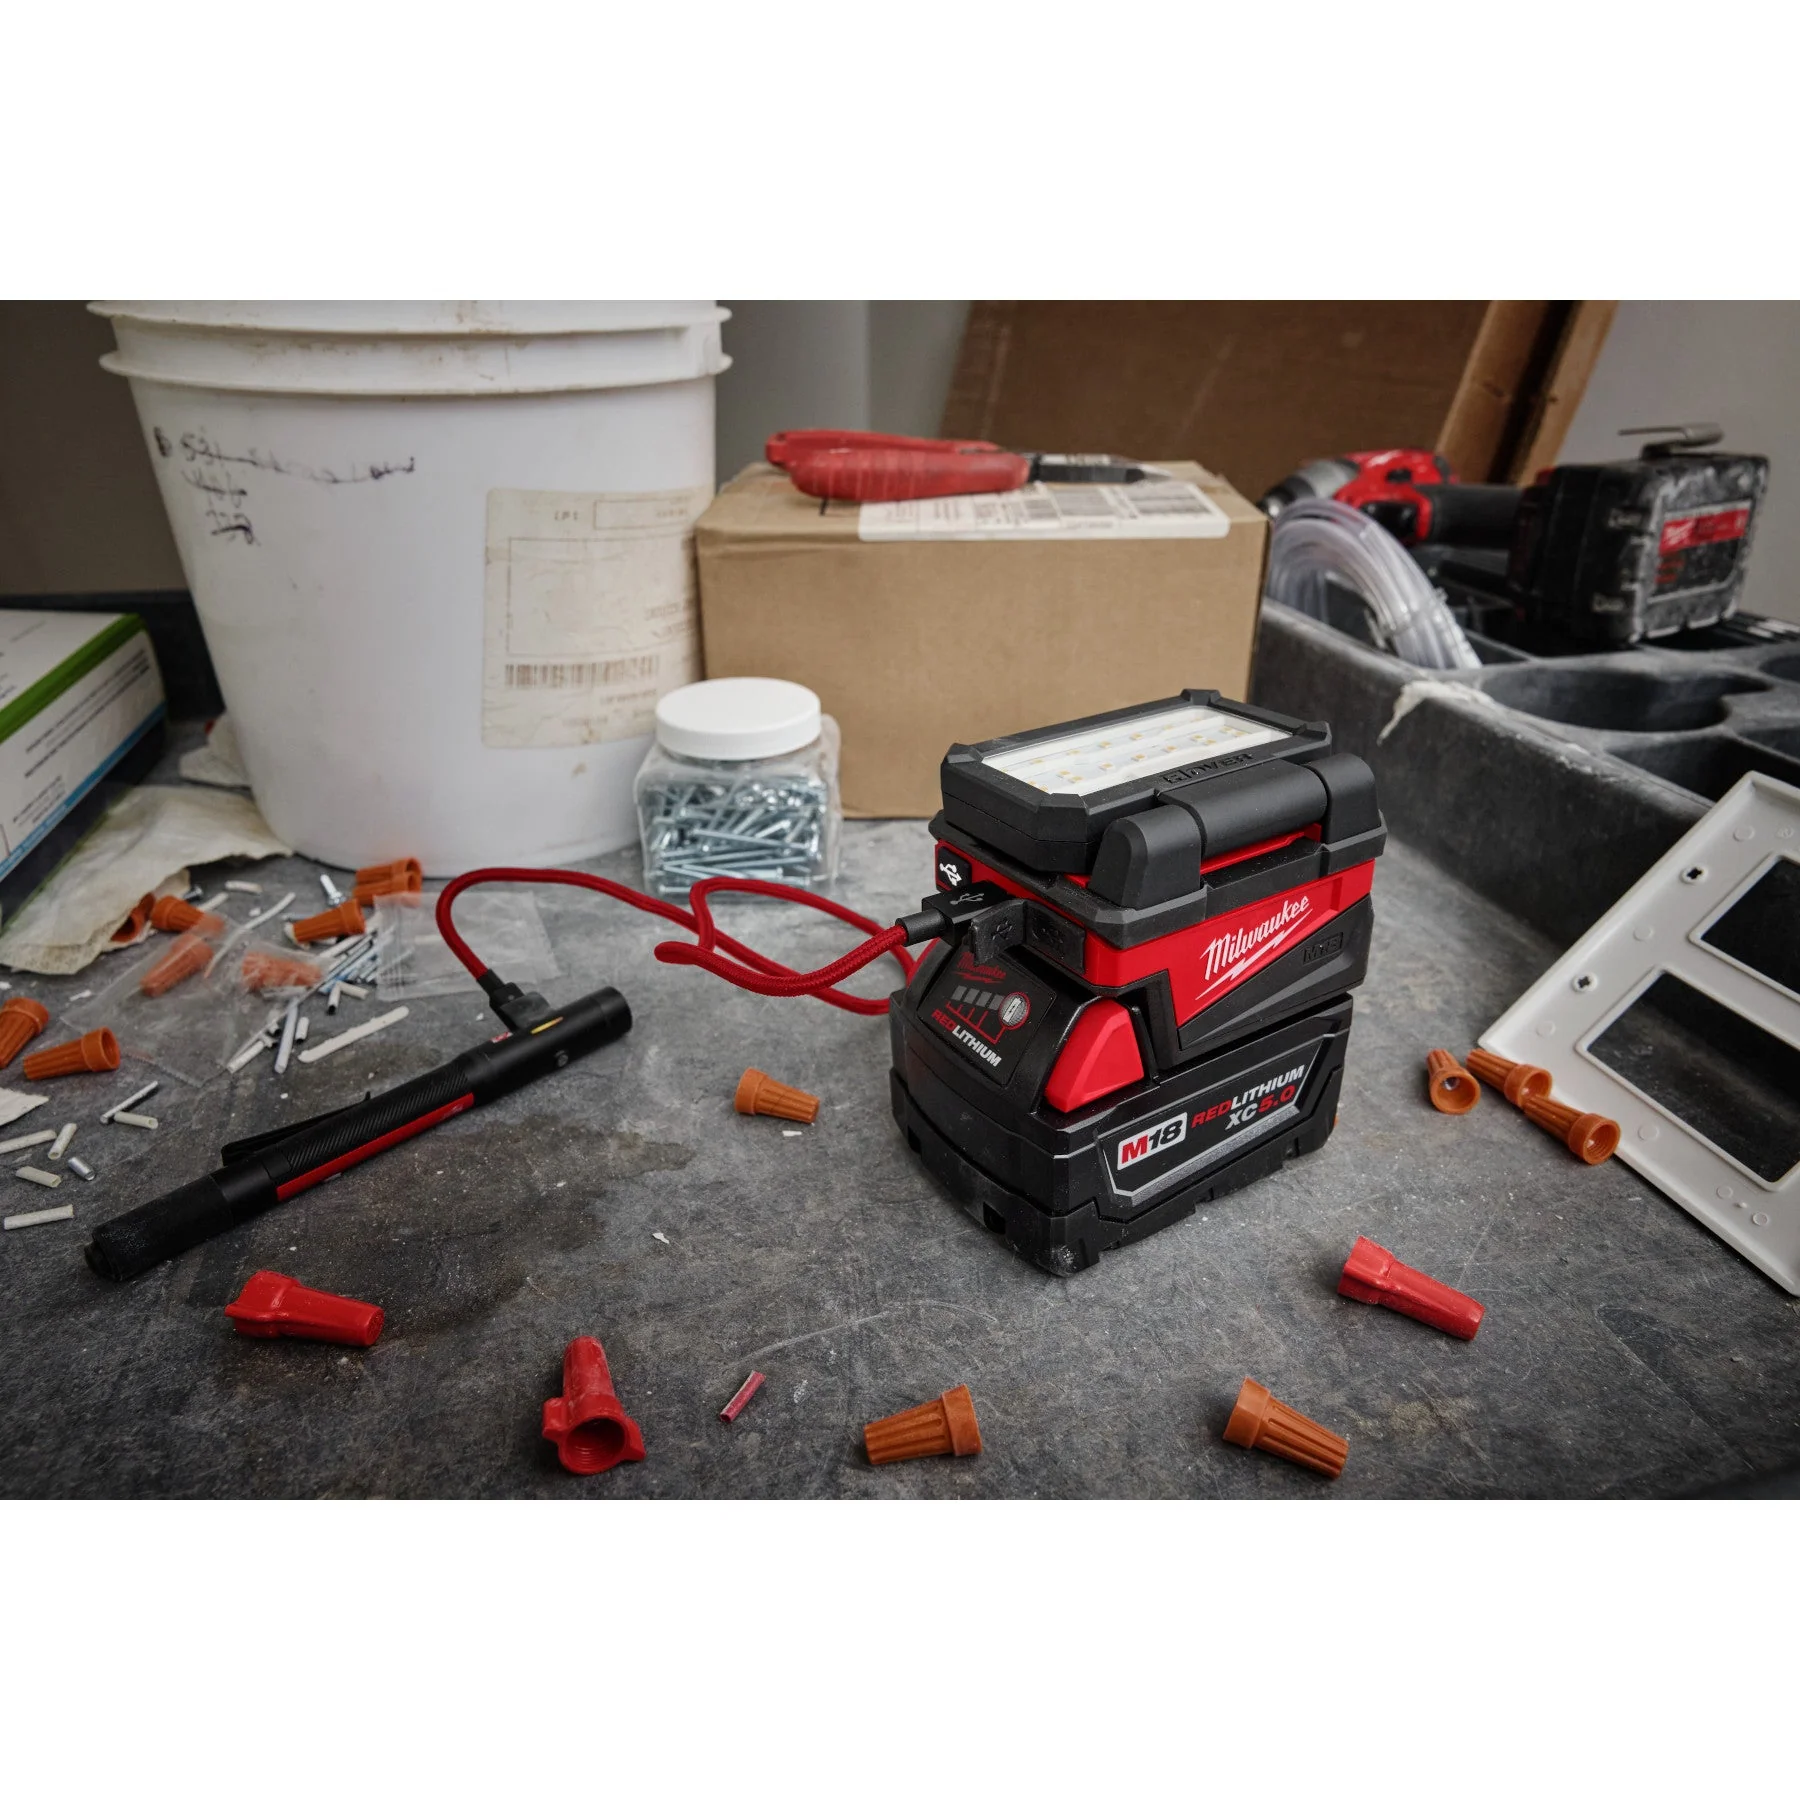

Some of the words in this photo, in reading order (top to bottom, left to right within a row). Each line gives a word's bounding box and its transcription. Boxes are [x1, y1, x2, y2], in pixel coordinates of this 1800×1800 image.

[1199, 895, 1310, 981] Milwaukee
[931, 1008, 1002, 1067] REDLITHIUM
[1190, 1064, 1305, 1129] REDLITHIUM
[1121, 1118, 1182, 1165] M18
